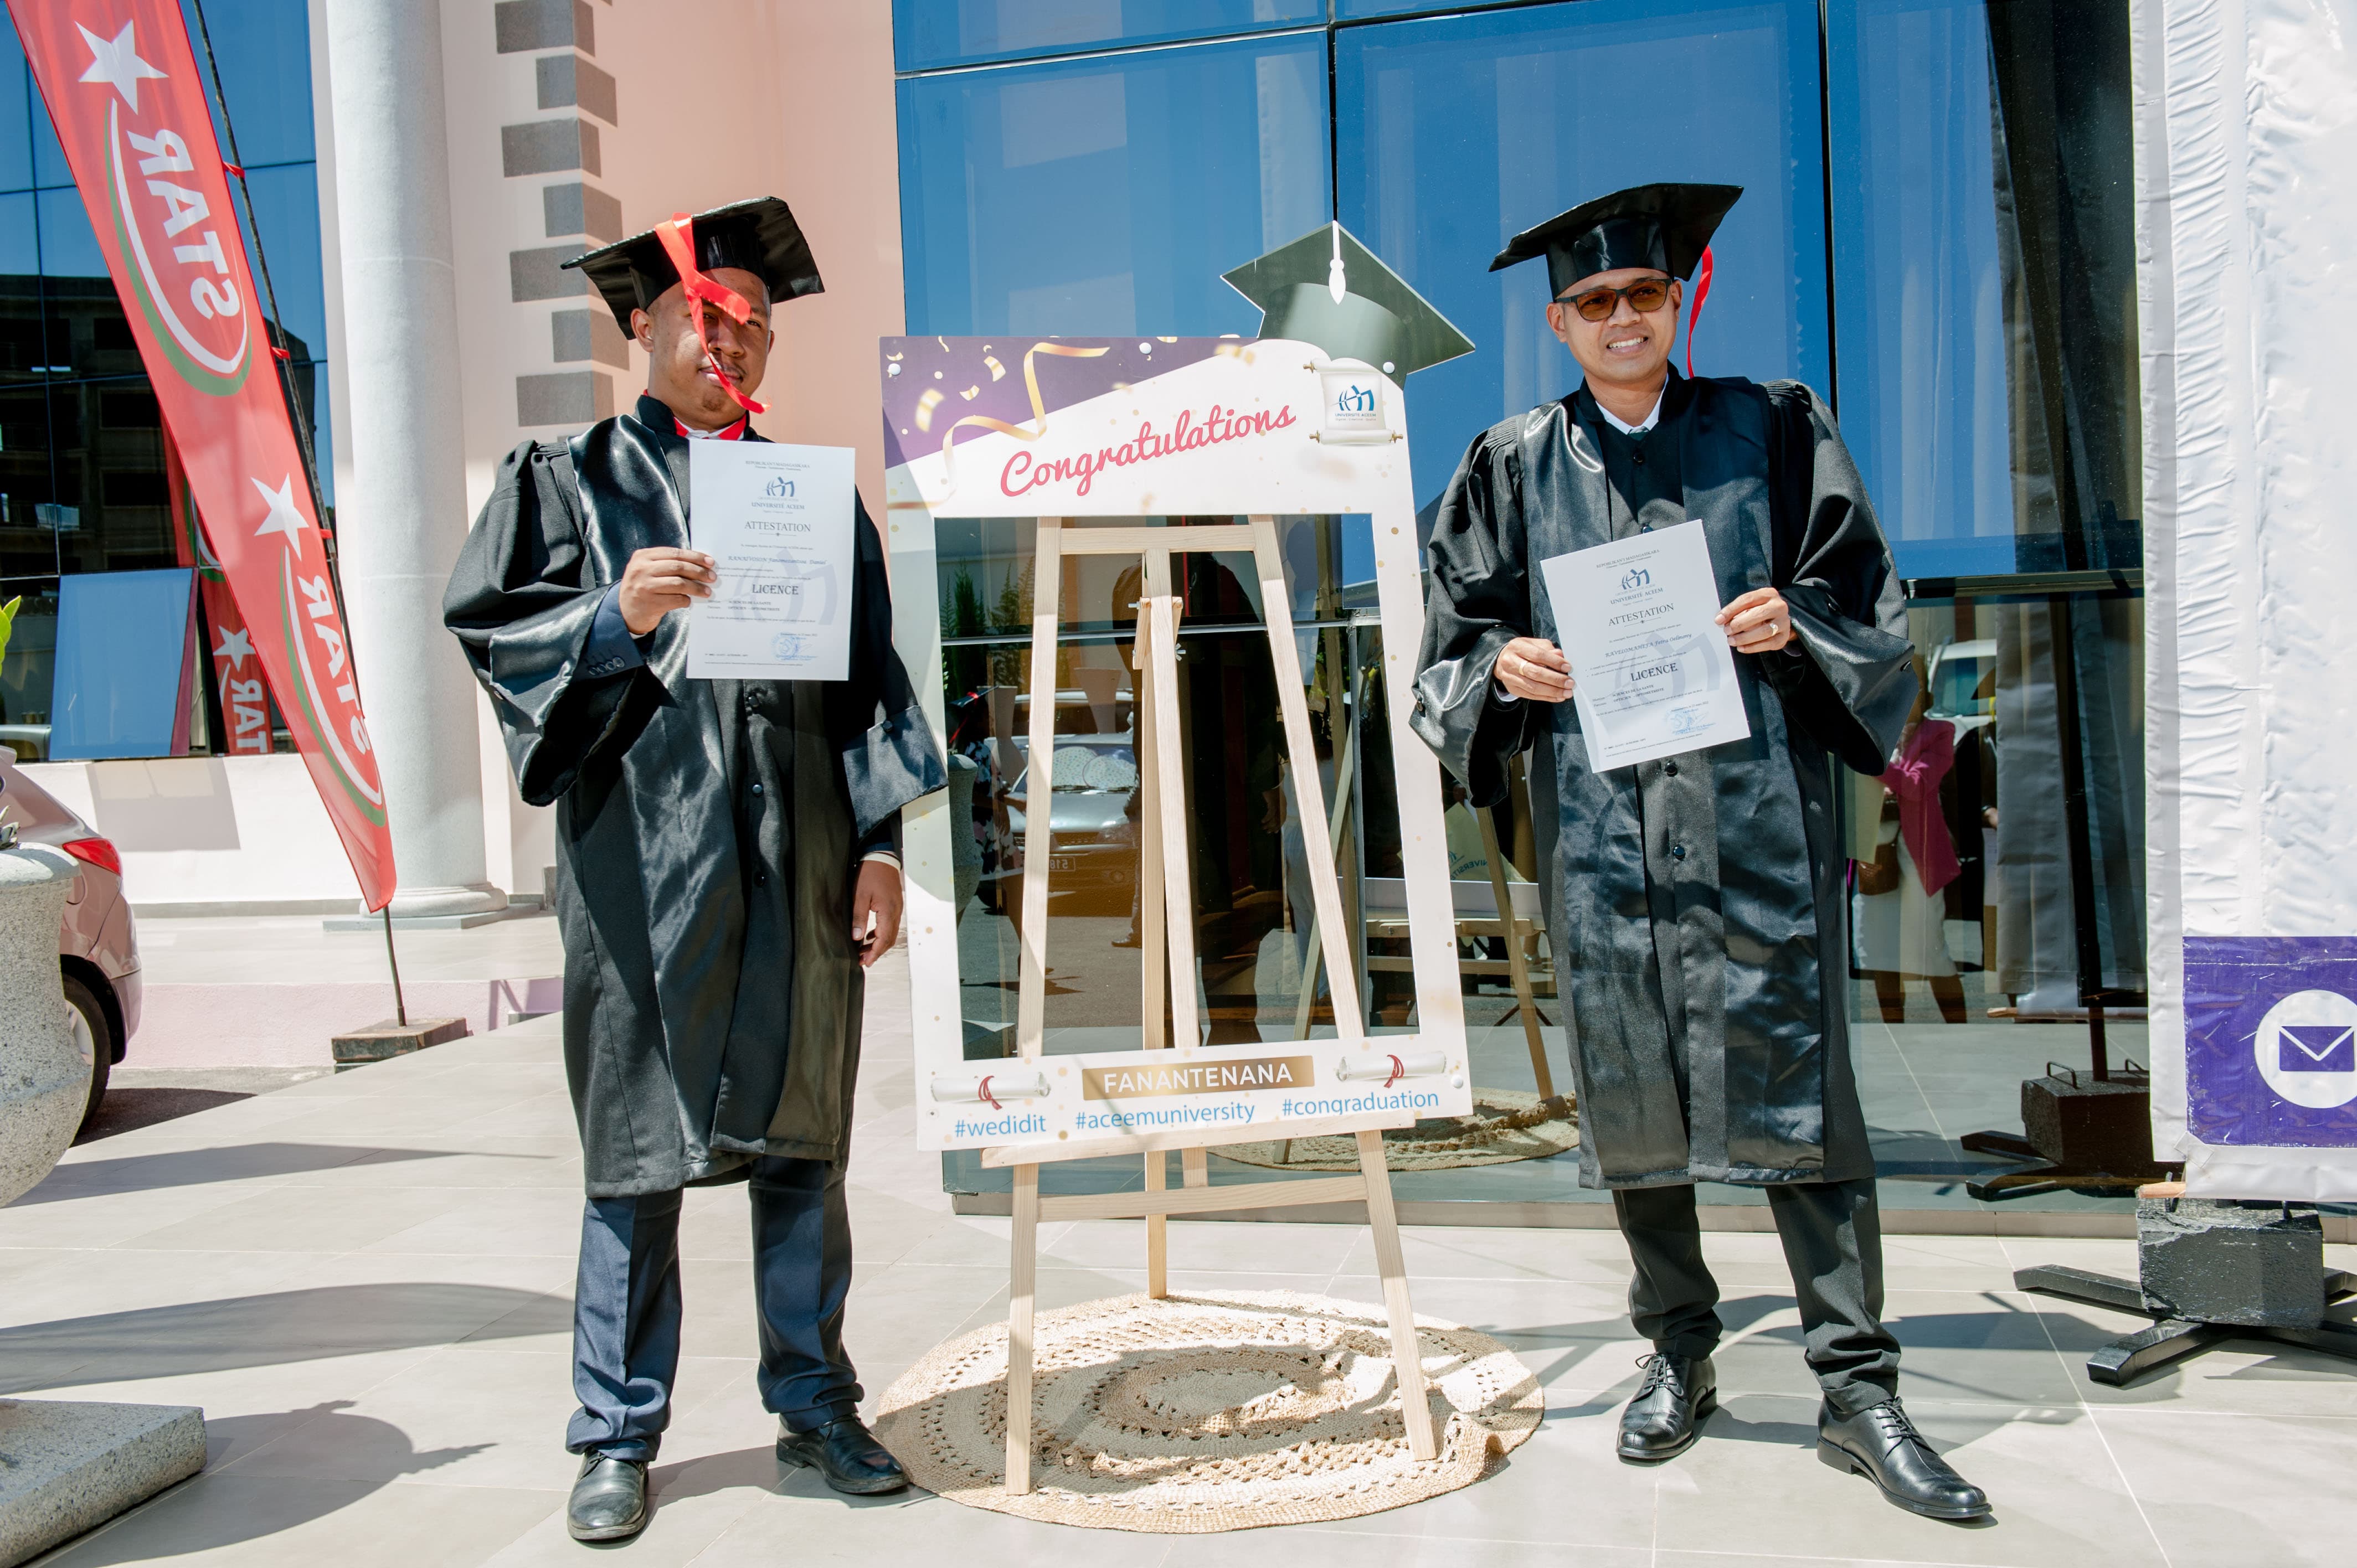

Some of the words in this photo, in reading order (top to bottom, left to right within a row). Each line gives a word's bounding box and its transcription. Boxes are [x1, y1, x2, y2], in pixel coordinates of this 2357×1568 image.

[1000, 404, 1296, 497] Congratulations
[744, 520, 811, 532] ATTESTATION
[752, 584, 799, 595] LICENCE
[1644, 587, 1664, 596] ACEEM
[1608, 602, 1675, 627] ATTESTATION
[1630, 662, 1679, 682] LICENCE
[1103, 1063, 1294, 1094] FANANTENANA
[954, 1113, 1046, 1138] #wedidit
[1075, 1102, 1255, 1130] #aceemuniversity
[1282, 1090, 1439, 1116] #congraduation
